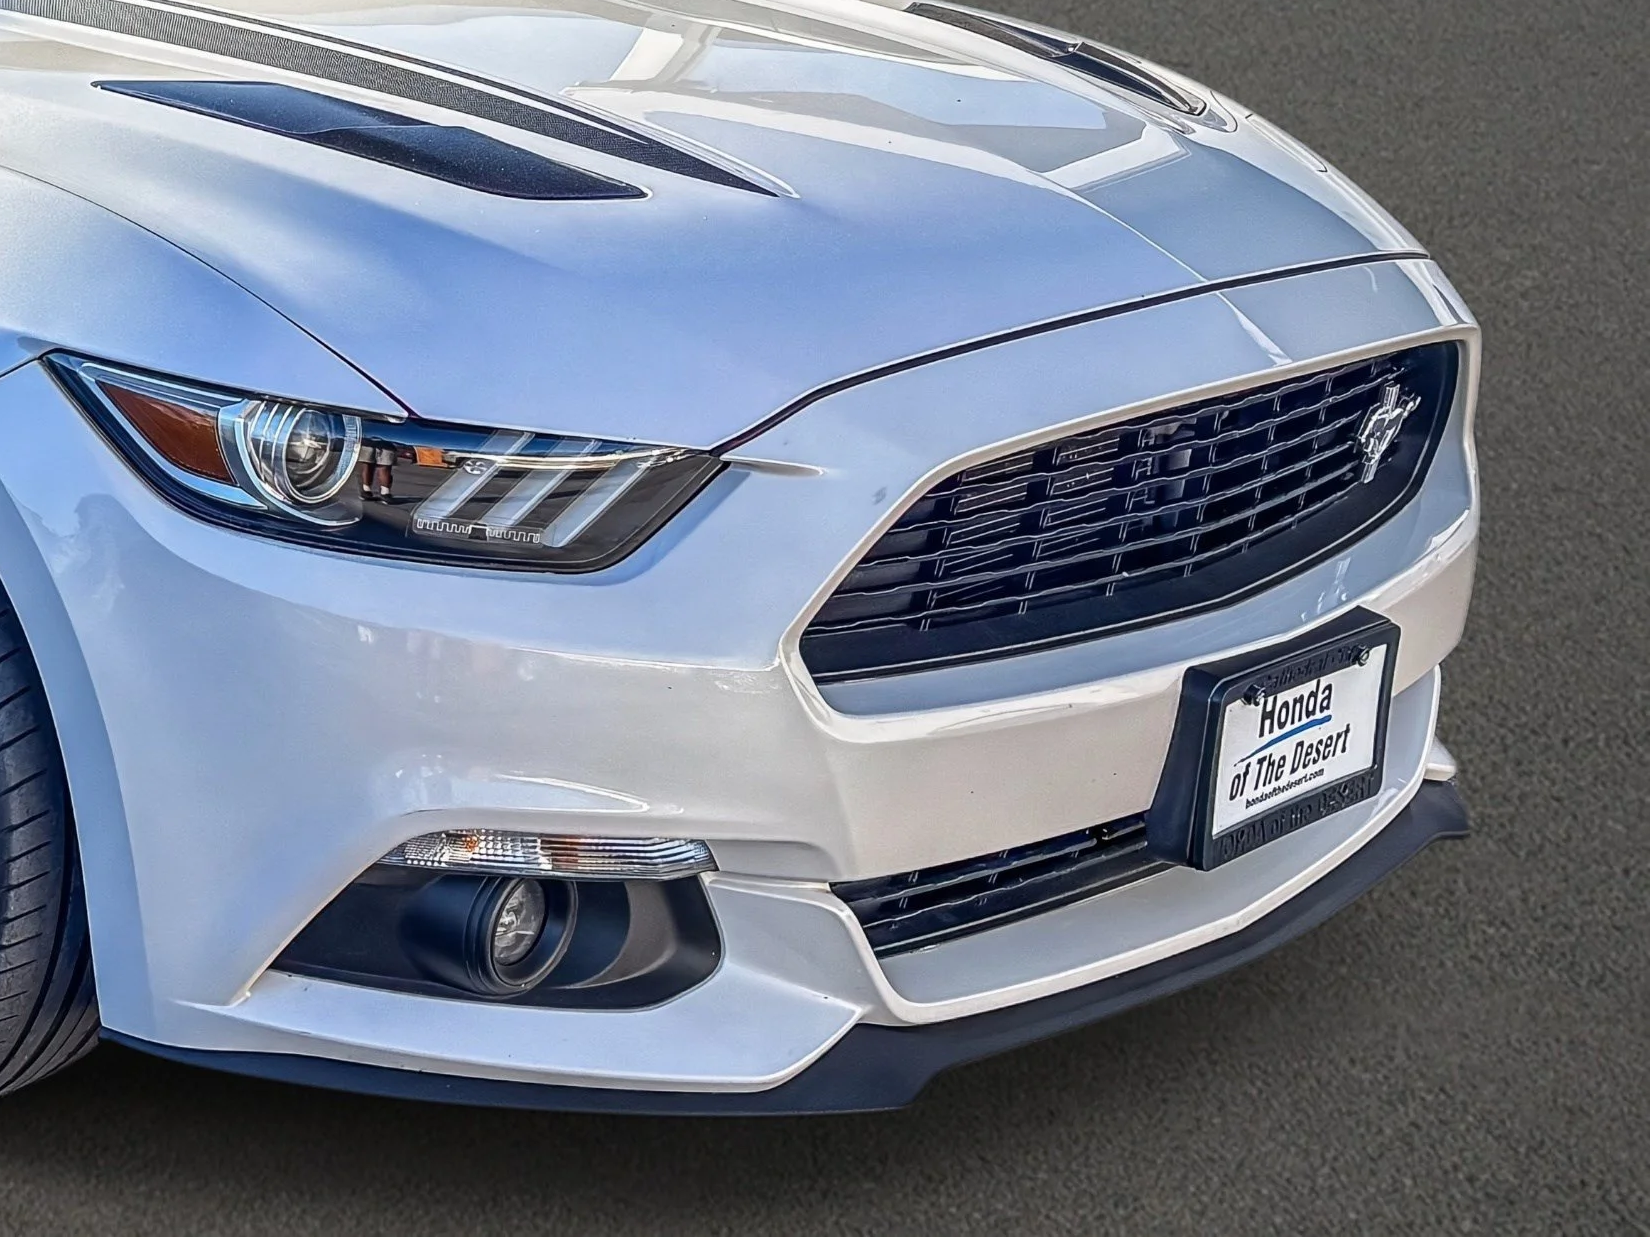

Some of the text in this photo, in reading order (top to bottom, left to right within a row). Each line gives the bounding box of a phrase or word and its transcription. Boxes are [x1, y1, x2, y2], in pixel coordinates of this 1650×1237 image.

[1258, 678, 1334, 739] Honda
[1229, 723, 1351, 801] of The Desert
